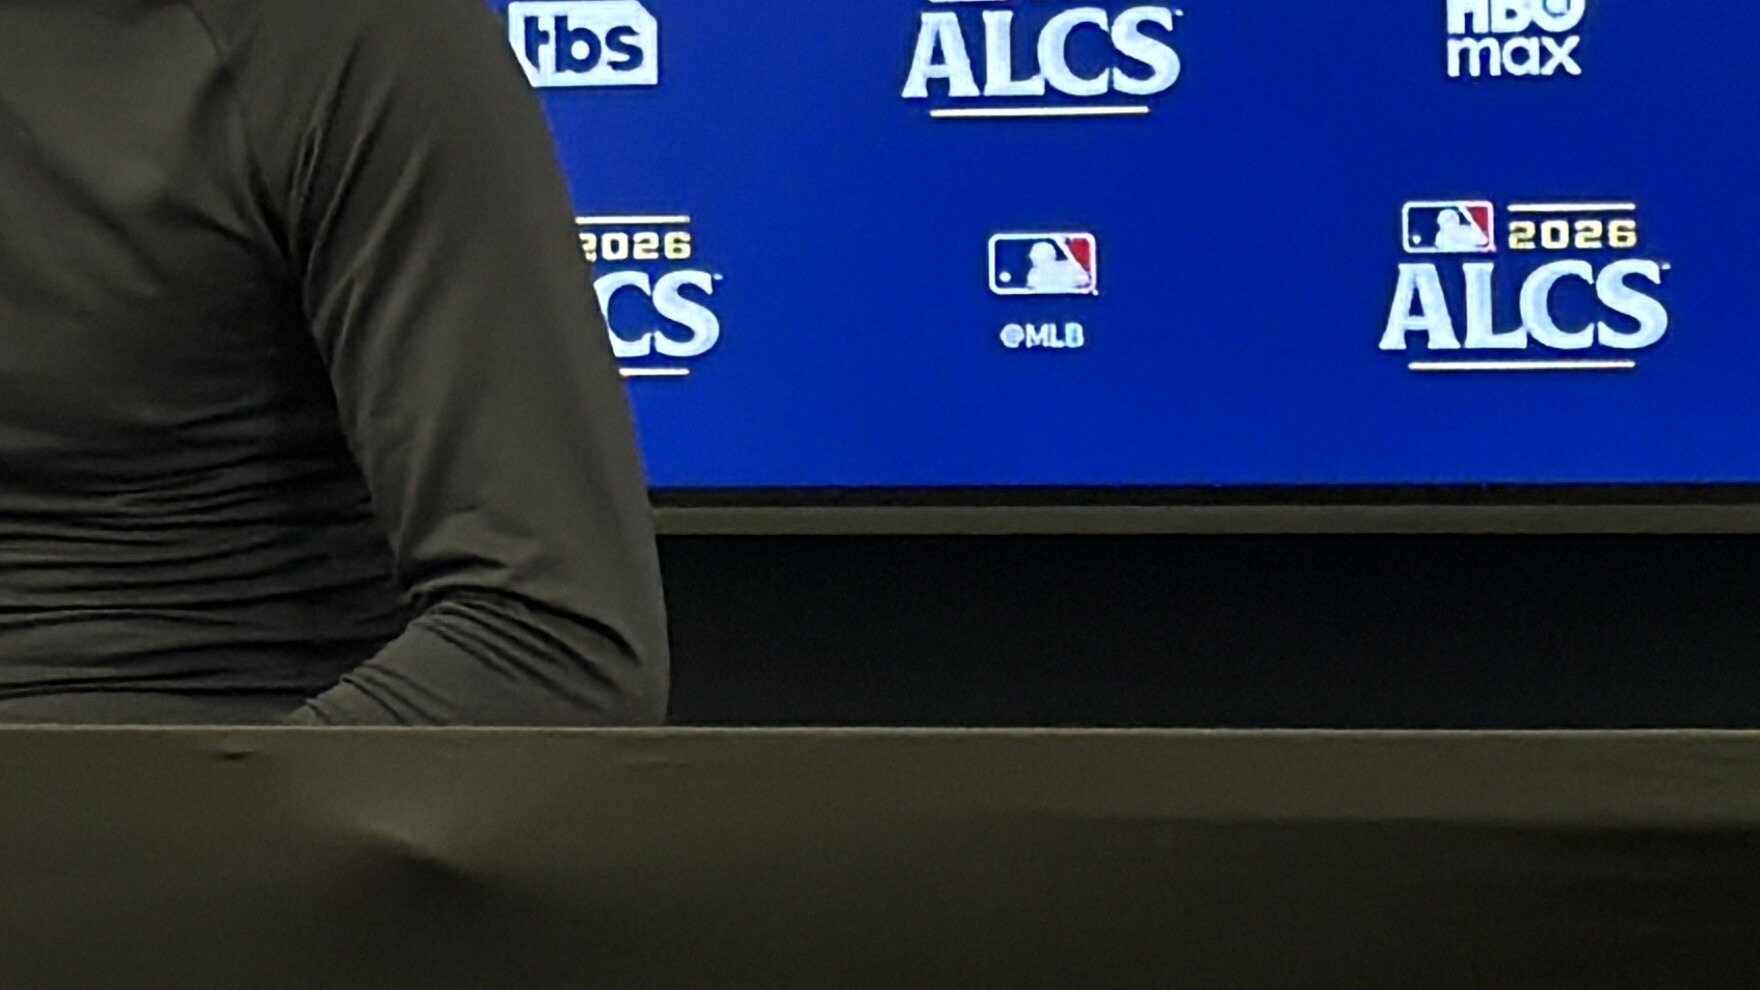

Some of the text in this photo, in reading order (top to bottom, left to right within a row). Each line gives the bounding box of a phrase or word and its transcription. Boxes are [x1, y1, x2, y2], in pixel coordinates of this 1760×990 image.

[524, 14, 644, 74] tbs
[901, 6, 1182, 98] ALCS
[1447, 35, 1582, 77] max
[1508, 220, 1637, 250] 2026
[595, 270, 720, 359] CS
[1379, 258, 1669, 351] ALCS
[1000, 324, 1084, 349] @MLB
